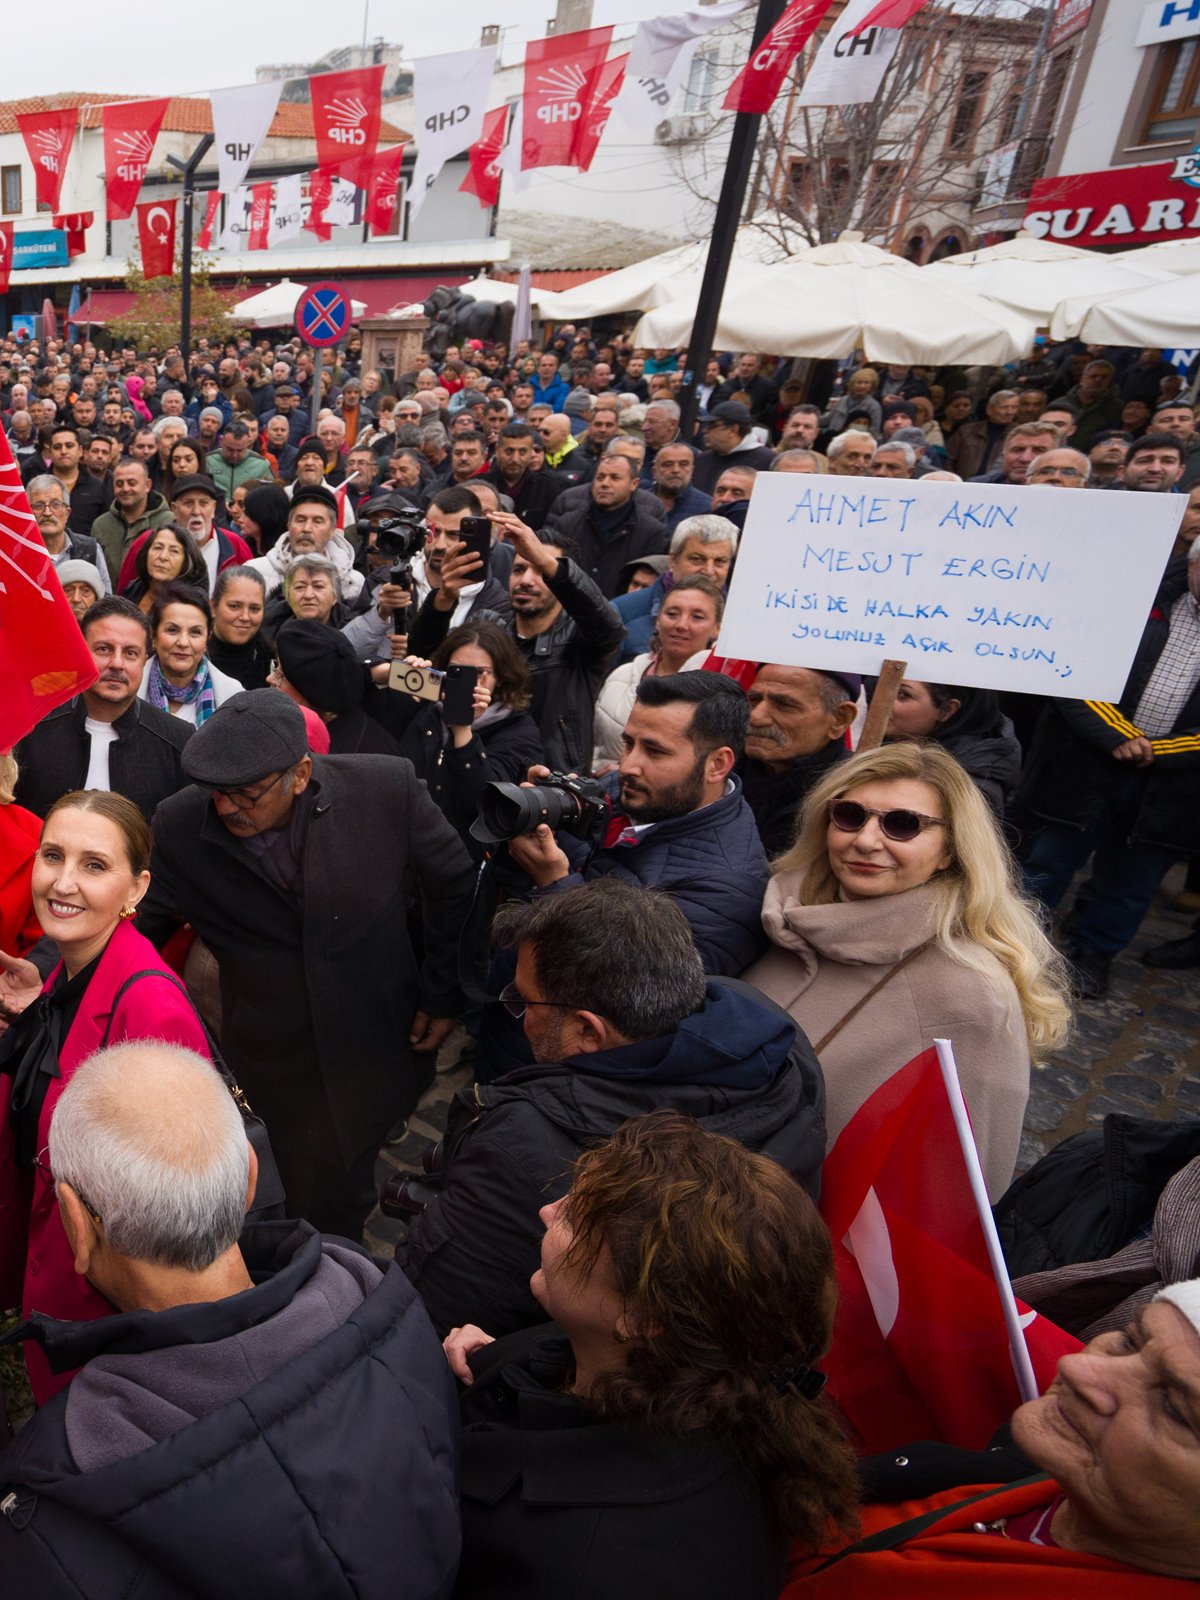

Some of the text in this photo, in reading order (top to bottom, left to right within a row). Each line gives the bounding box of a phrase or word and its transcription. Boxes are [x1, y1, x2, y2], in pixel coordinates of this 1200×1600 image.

[834, 26, 883, 58] CH
[788, 488, 1019, 532] AHMET AKIN
[802, 543, 1051, 583] MESUT ERGİN
[864, 599, 950, 620] HALKA
[966, 606, 1054, 631] YAKIN
[792, 623, 886, 647] YOLUNUZ
[901, 633, 954, 654] AÇIK
[974, 642, 1056, 664] OLSUN
